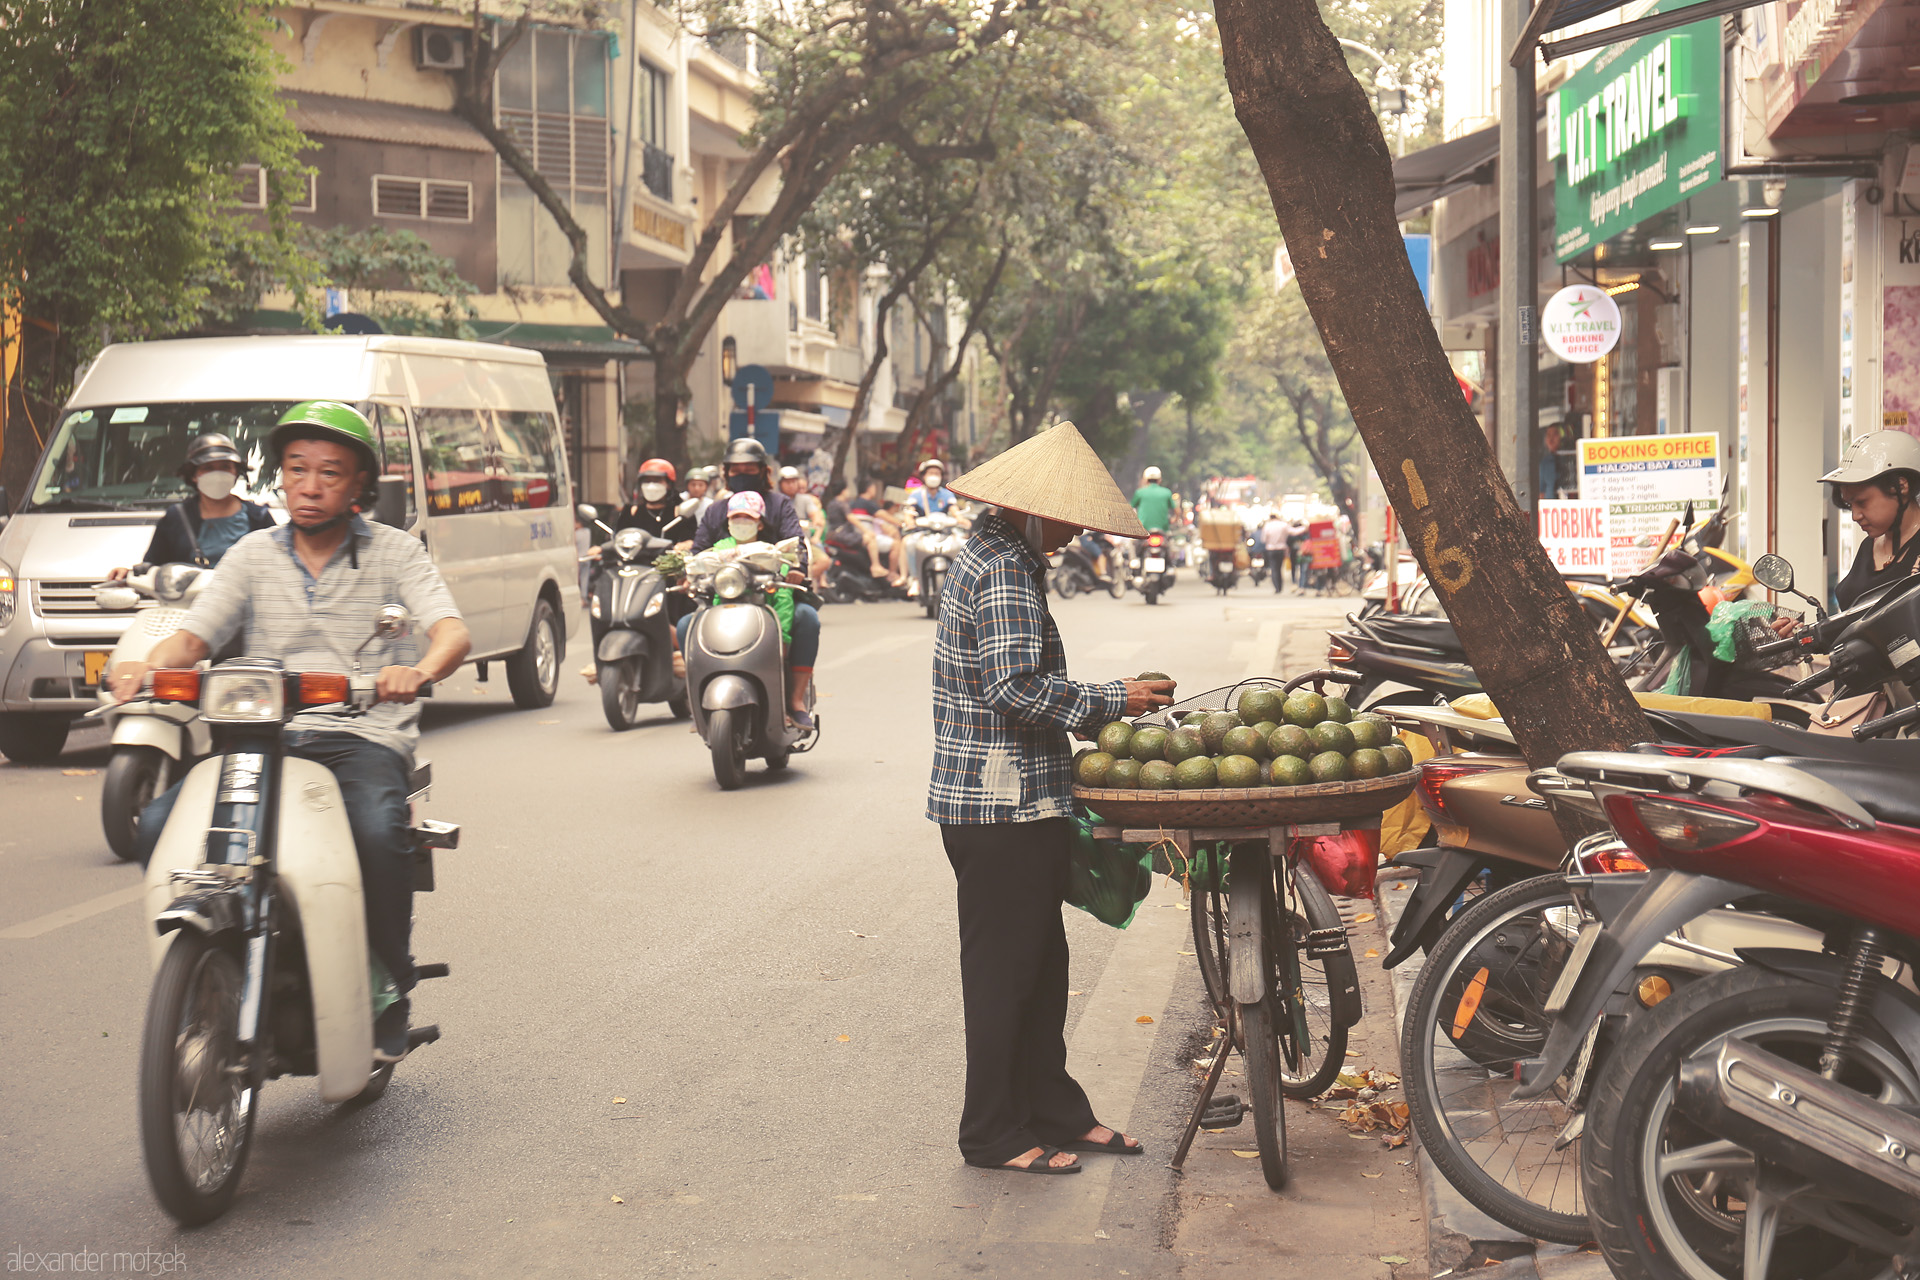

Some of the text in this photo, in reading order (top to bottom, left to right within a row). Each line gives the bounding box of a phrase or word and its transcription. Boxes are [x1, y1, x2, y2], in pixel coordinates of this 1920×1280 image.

[1566, 94, 1600, 187] V.I.T
[1603, 37, 1678, 163] TRAVEL
[1550, 321, 1616, 333] V.I.T TRAVEL
[1562, 334, 1604, 343] BOOKING
[1568, 344, 1599, 353] OFFICE
[1588, 440, 1711, 460] BOOKING OFFICE
[1597, 458, 1702, 473] HALONG BAY TOUR
[1608, 476, 1620, 485] day
[1608, 485, 1625, 494] days
[1608, 493, 1625, 502] days
[1625, 503, 1678, 513] TREKKING
[1681, 501, 1710, 510] TUR
[1557, 547, 1567, 566] &
[1571, 547, 1606, 566] RENT
